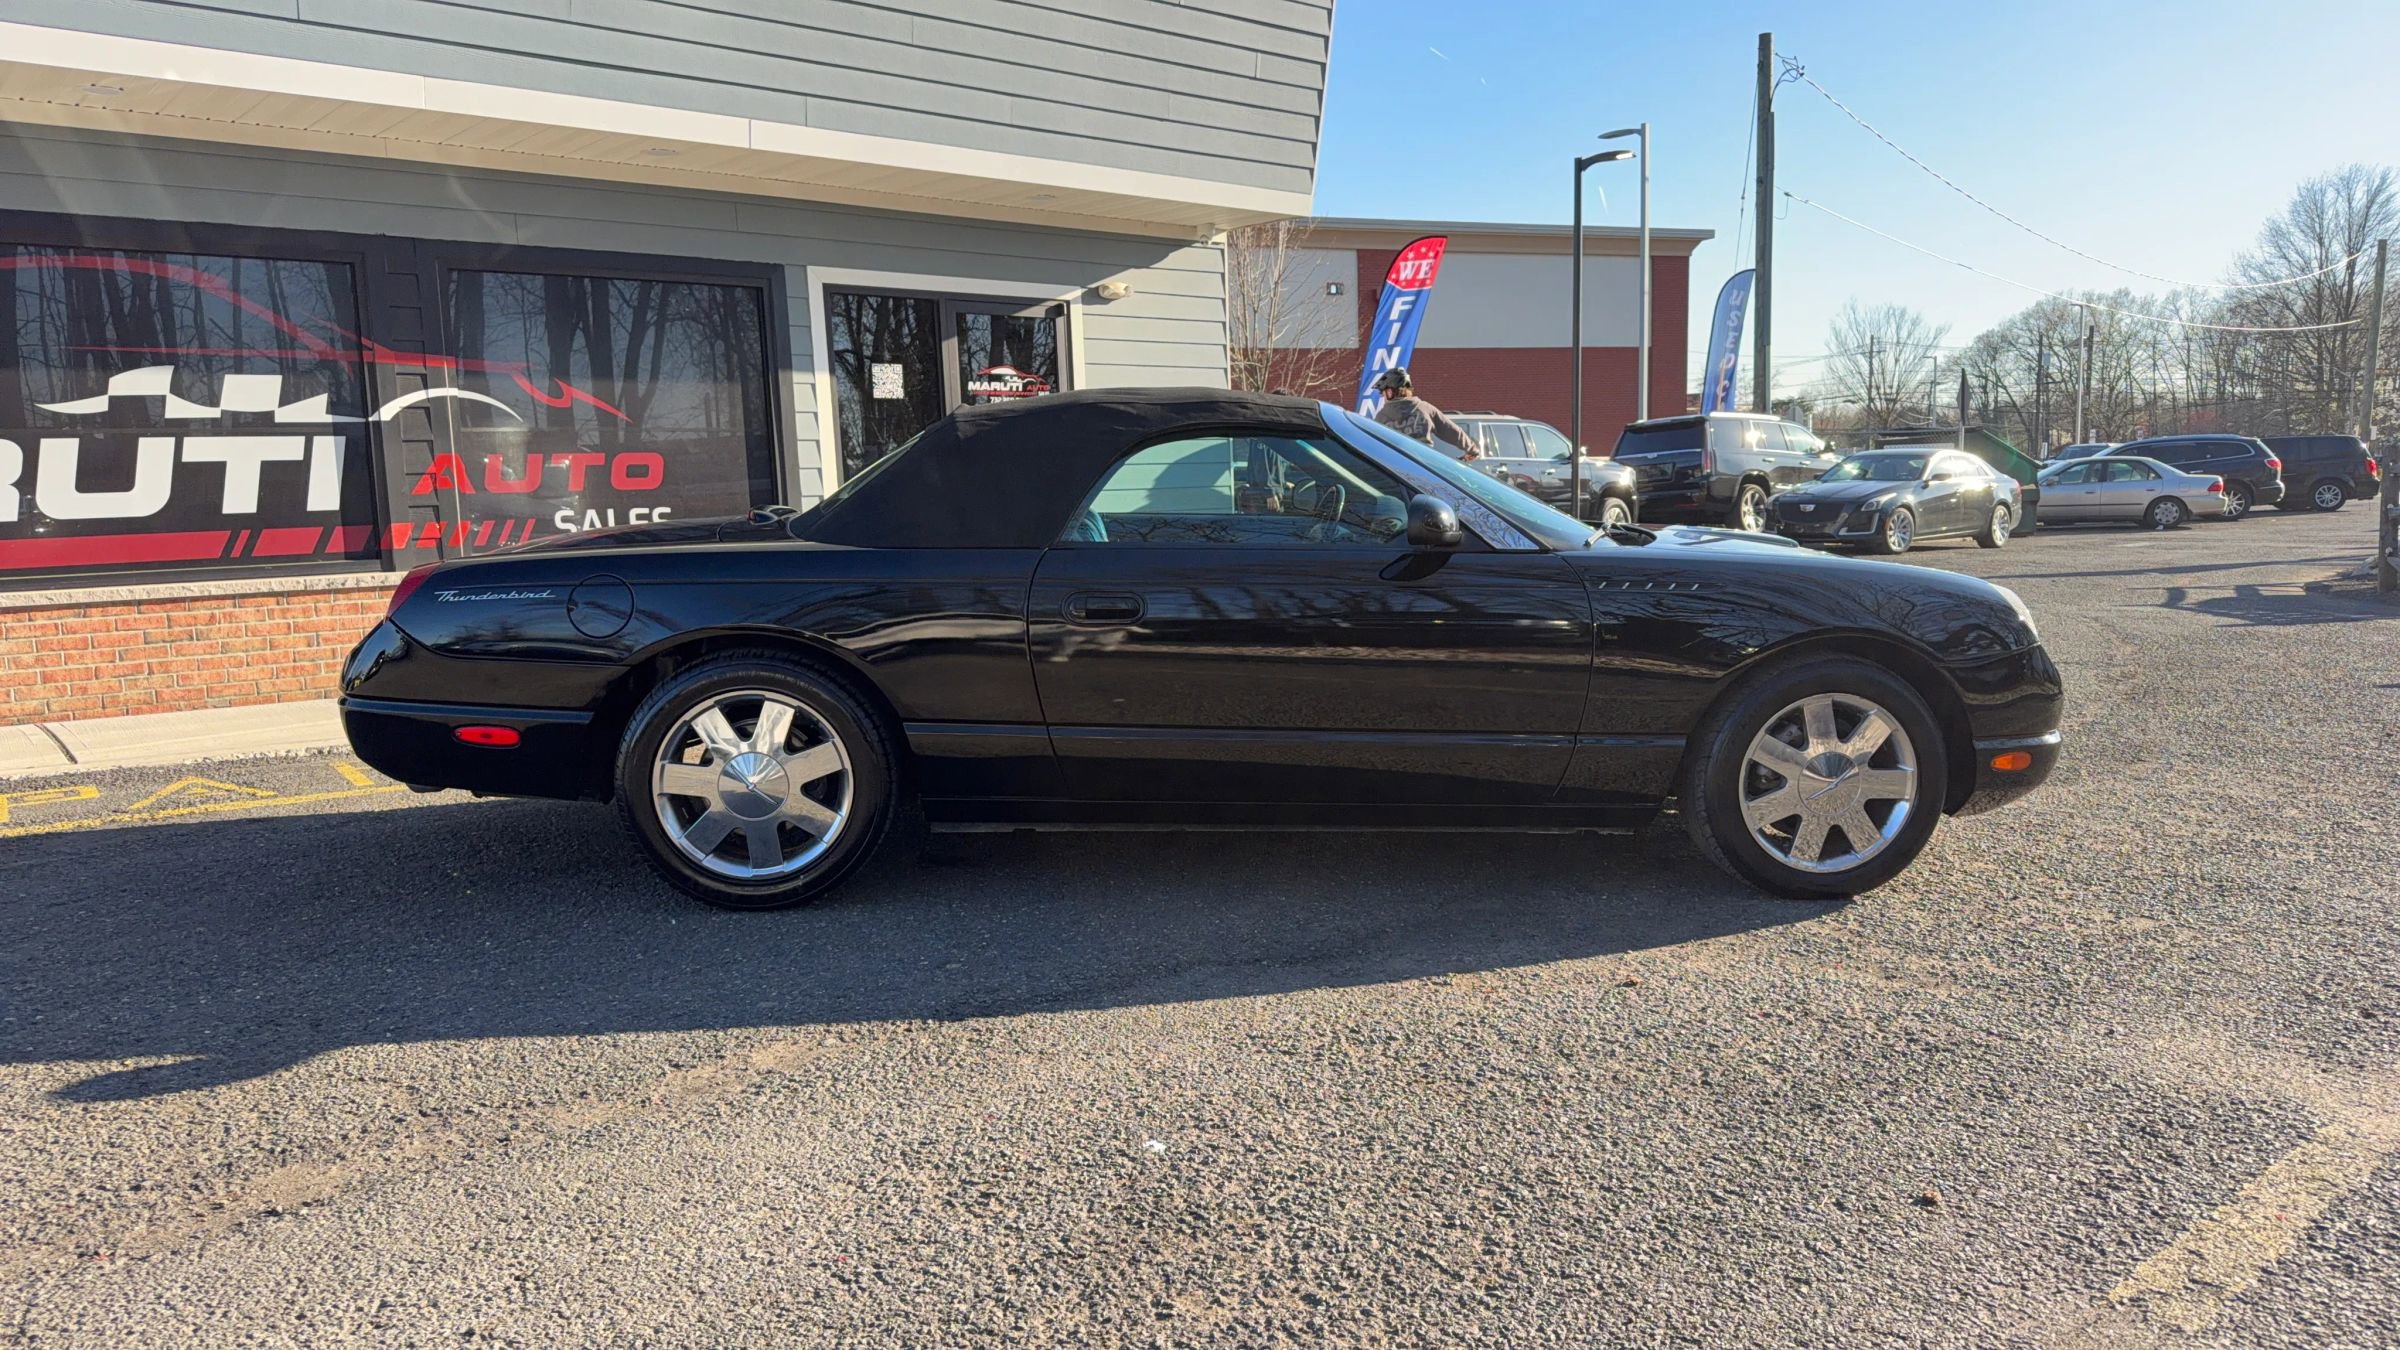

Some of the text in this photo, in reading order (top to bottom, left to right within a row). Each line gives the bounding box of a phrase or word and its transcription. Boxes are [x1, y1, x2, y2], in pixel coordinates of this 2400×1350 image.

[1400, 258, 1435, 281] WE
[1720, 288, 1745, 370] USED
[967, 381, 1024, 392] MARUTI
[0, 435, 665, 522] UTI AUTO
[434, 590, 557, 602] Thunderbird
